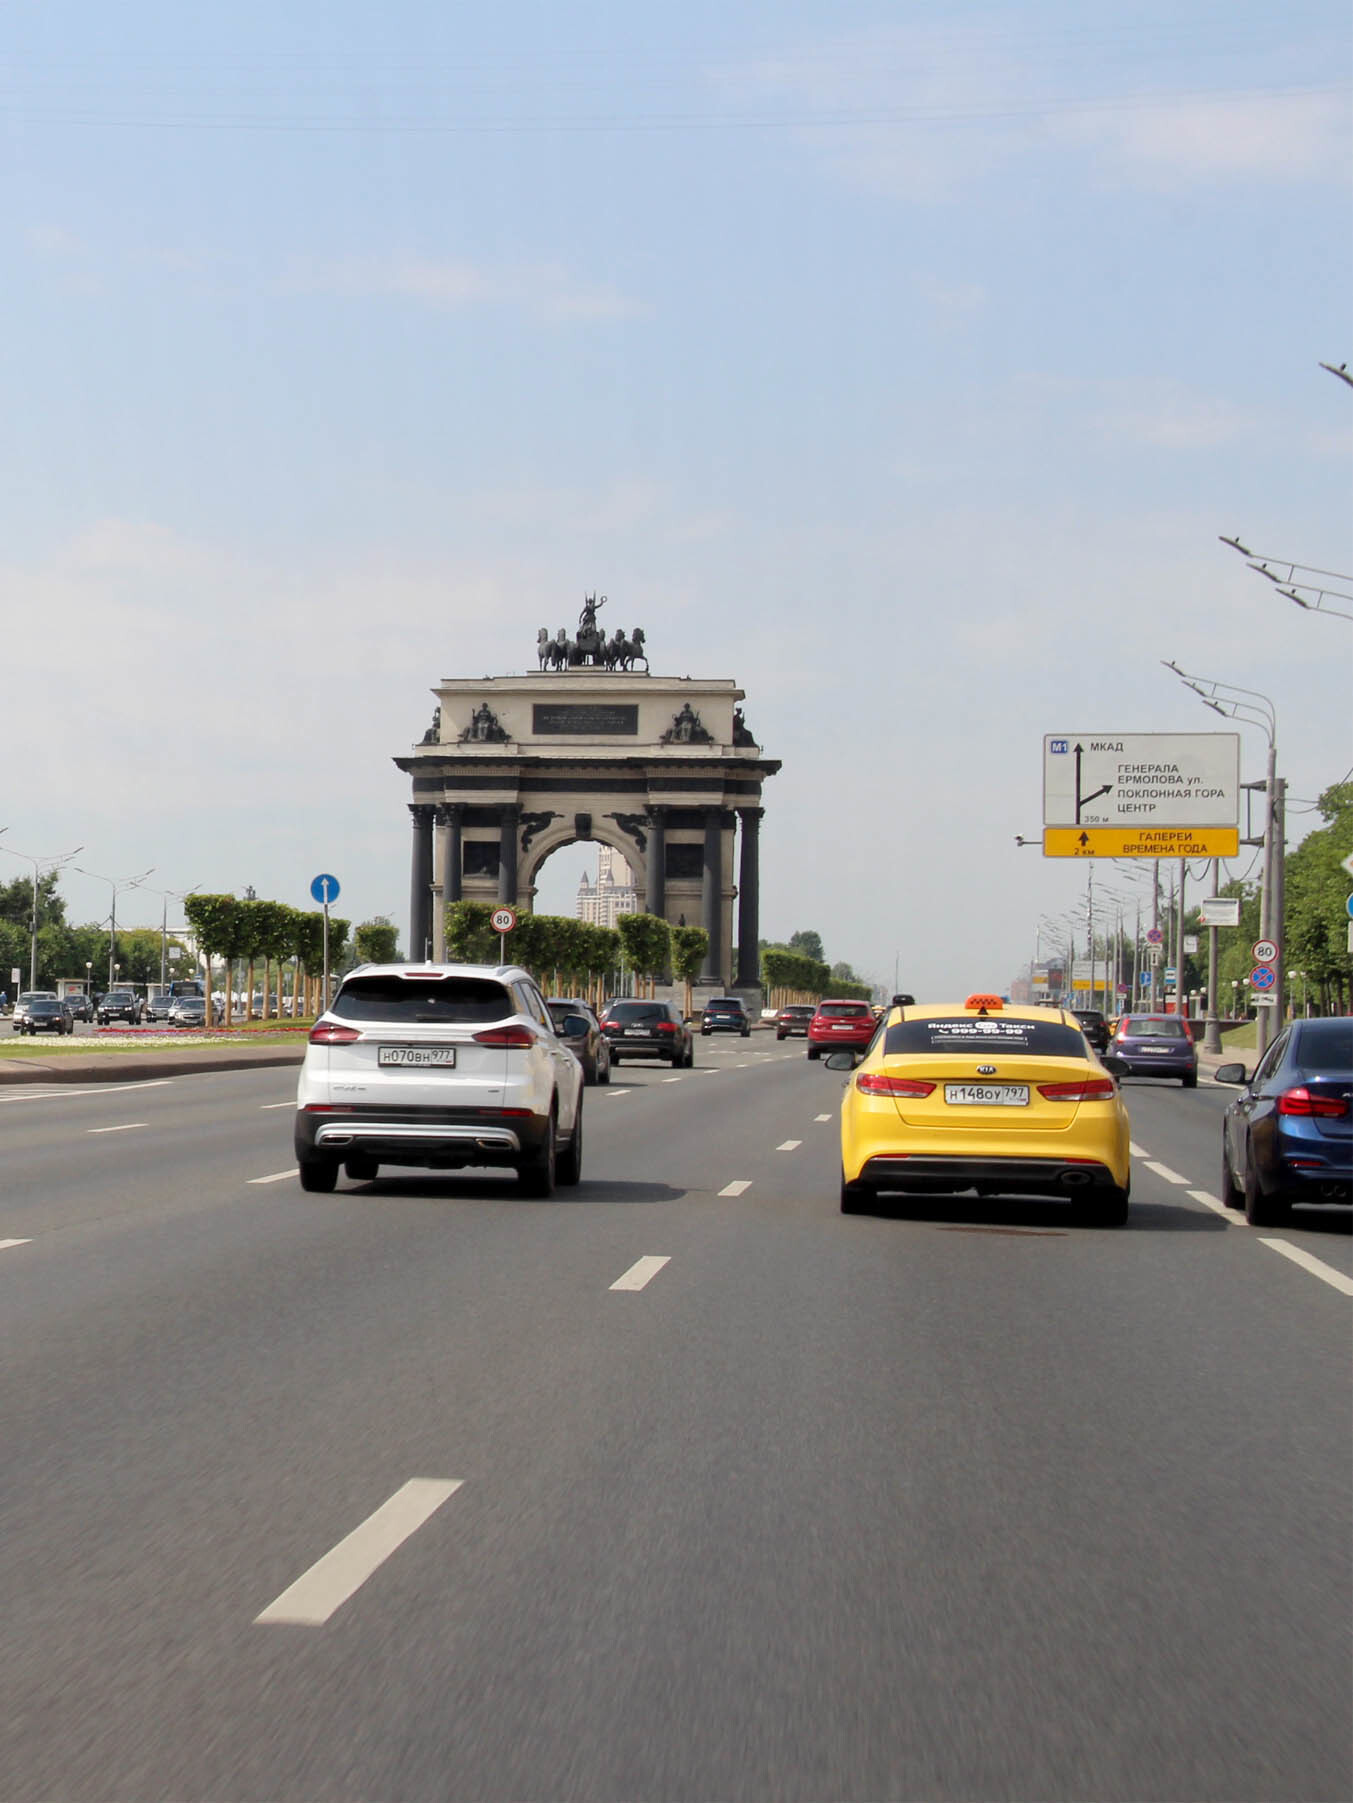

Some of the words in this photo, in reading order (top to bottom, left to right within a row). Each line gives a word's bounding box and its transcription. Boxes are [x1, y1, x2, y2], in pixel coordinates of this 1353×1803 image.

[1052, 742, 1067, 752] М1
[1090, 742, 1123, 752] МКАД
[1118, 764, 1179, 773] ГЕНЕРАЛА
[1118, 775, 1183, 784] ЕРМОЛОВА
[1187, 776, 1203, 785] ул.
[1117, 789, 1191, 798] ПОКЛОННАЯ
[1195, 789, 1225, 798] ГОРА
[1117, 803, 1156, 814] ЦЕНТР
[1139, 832, 1192, 841] ГАЛЕРЕИ
[1123, 844, 1175, 853] ВРЕМЕНА
[1178, 844, 1208, 854] ГОДА
[496, 915, 509, 924] 80
[1257, 946, 1273, 957] 80
[431, 1050, 451, 1060] 977
[1004, 1088, 1024, 1097] 797
